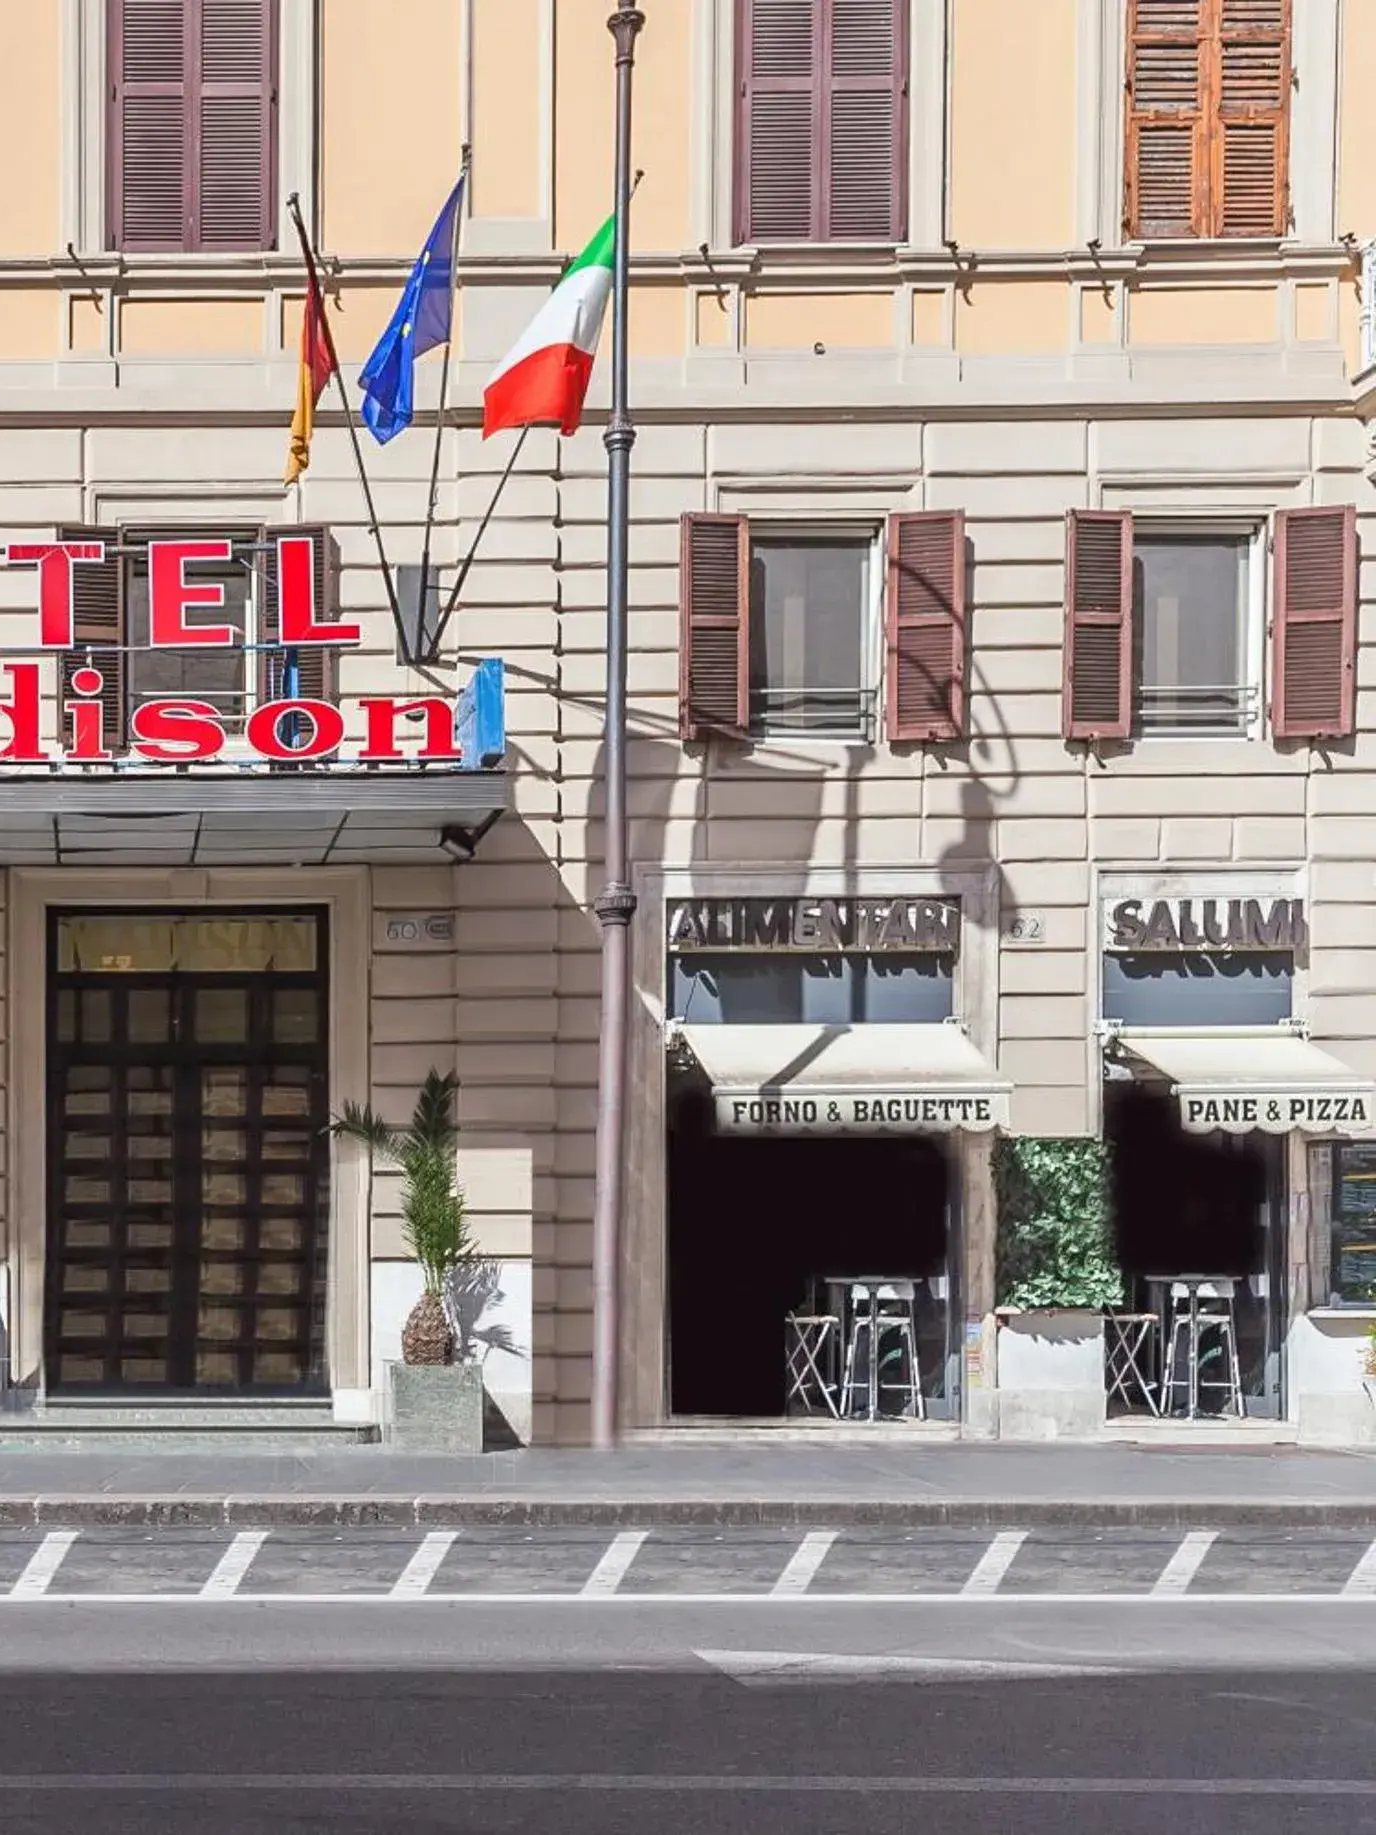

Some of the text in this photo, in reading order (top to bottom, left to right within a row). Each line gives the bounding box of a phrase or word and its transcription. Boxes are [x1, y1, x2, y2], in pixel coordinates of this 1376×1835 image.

[1011, 918, 1040, 938] 62
[1111, 899, 1305, 946] SALUMI
[733, 1099, 991, 1123] FORNO & BAGUETTE
[1188, 1098, 1367, 1122] PANE & PIZZA
